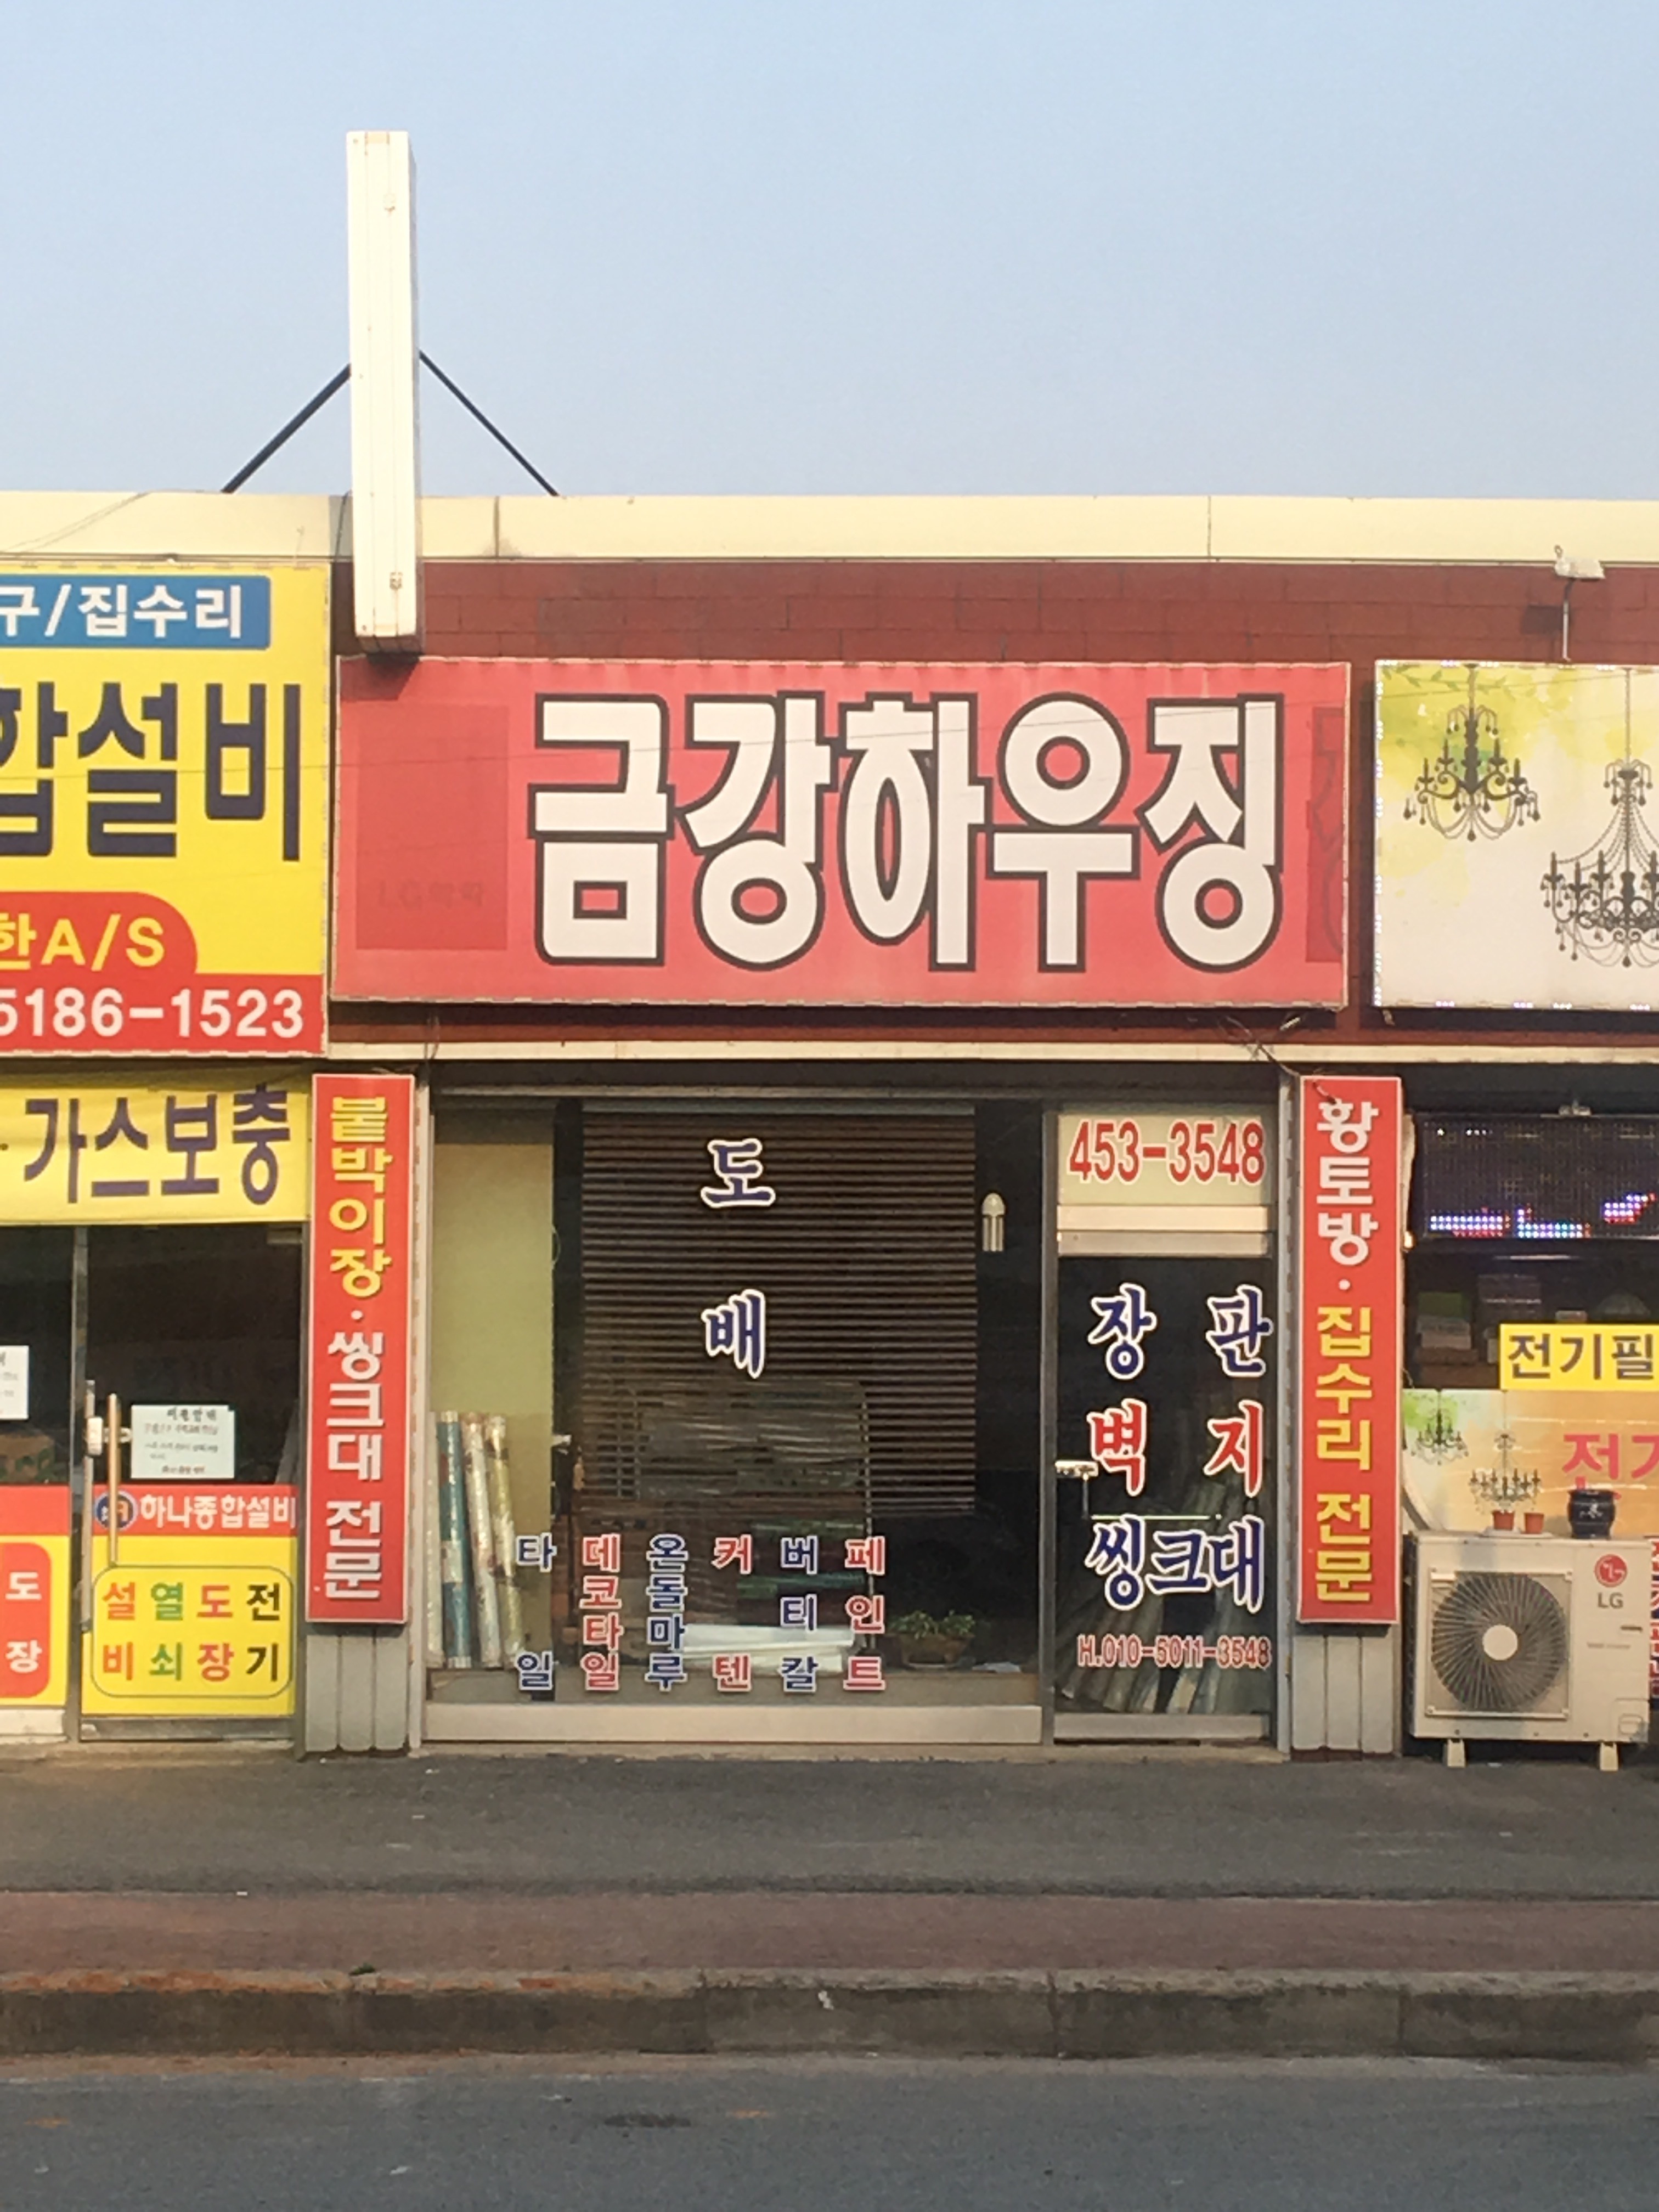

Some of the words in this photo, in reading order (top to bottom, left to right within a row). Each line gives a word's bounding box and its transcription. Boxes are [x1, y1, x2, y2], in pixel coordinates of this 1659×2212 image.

[528, 690, 1283, 971] 금강하우징
[1066, 1118, 1266, 1186] 453-3548
[1087, 1282, 1273, 1381] 장판
[1086, 1398, 1265, 1498] 벽지
[140, 1493, 296, 1531] 하나종합설비
[324, 1501, 382, 1599] 전문
[1315, 1491, 1373, 1603] 전문
[579, 1533, 623, 1692] 데코타일
[645, 1534, 688, 1692] 온돌마루
[1085, 1514, 1266, 1615] 씽크대
[1598, 1592, 1624, 1610] LG
